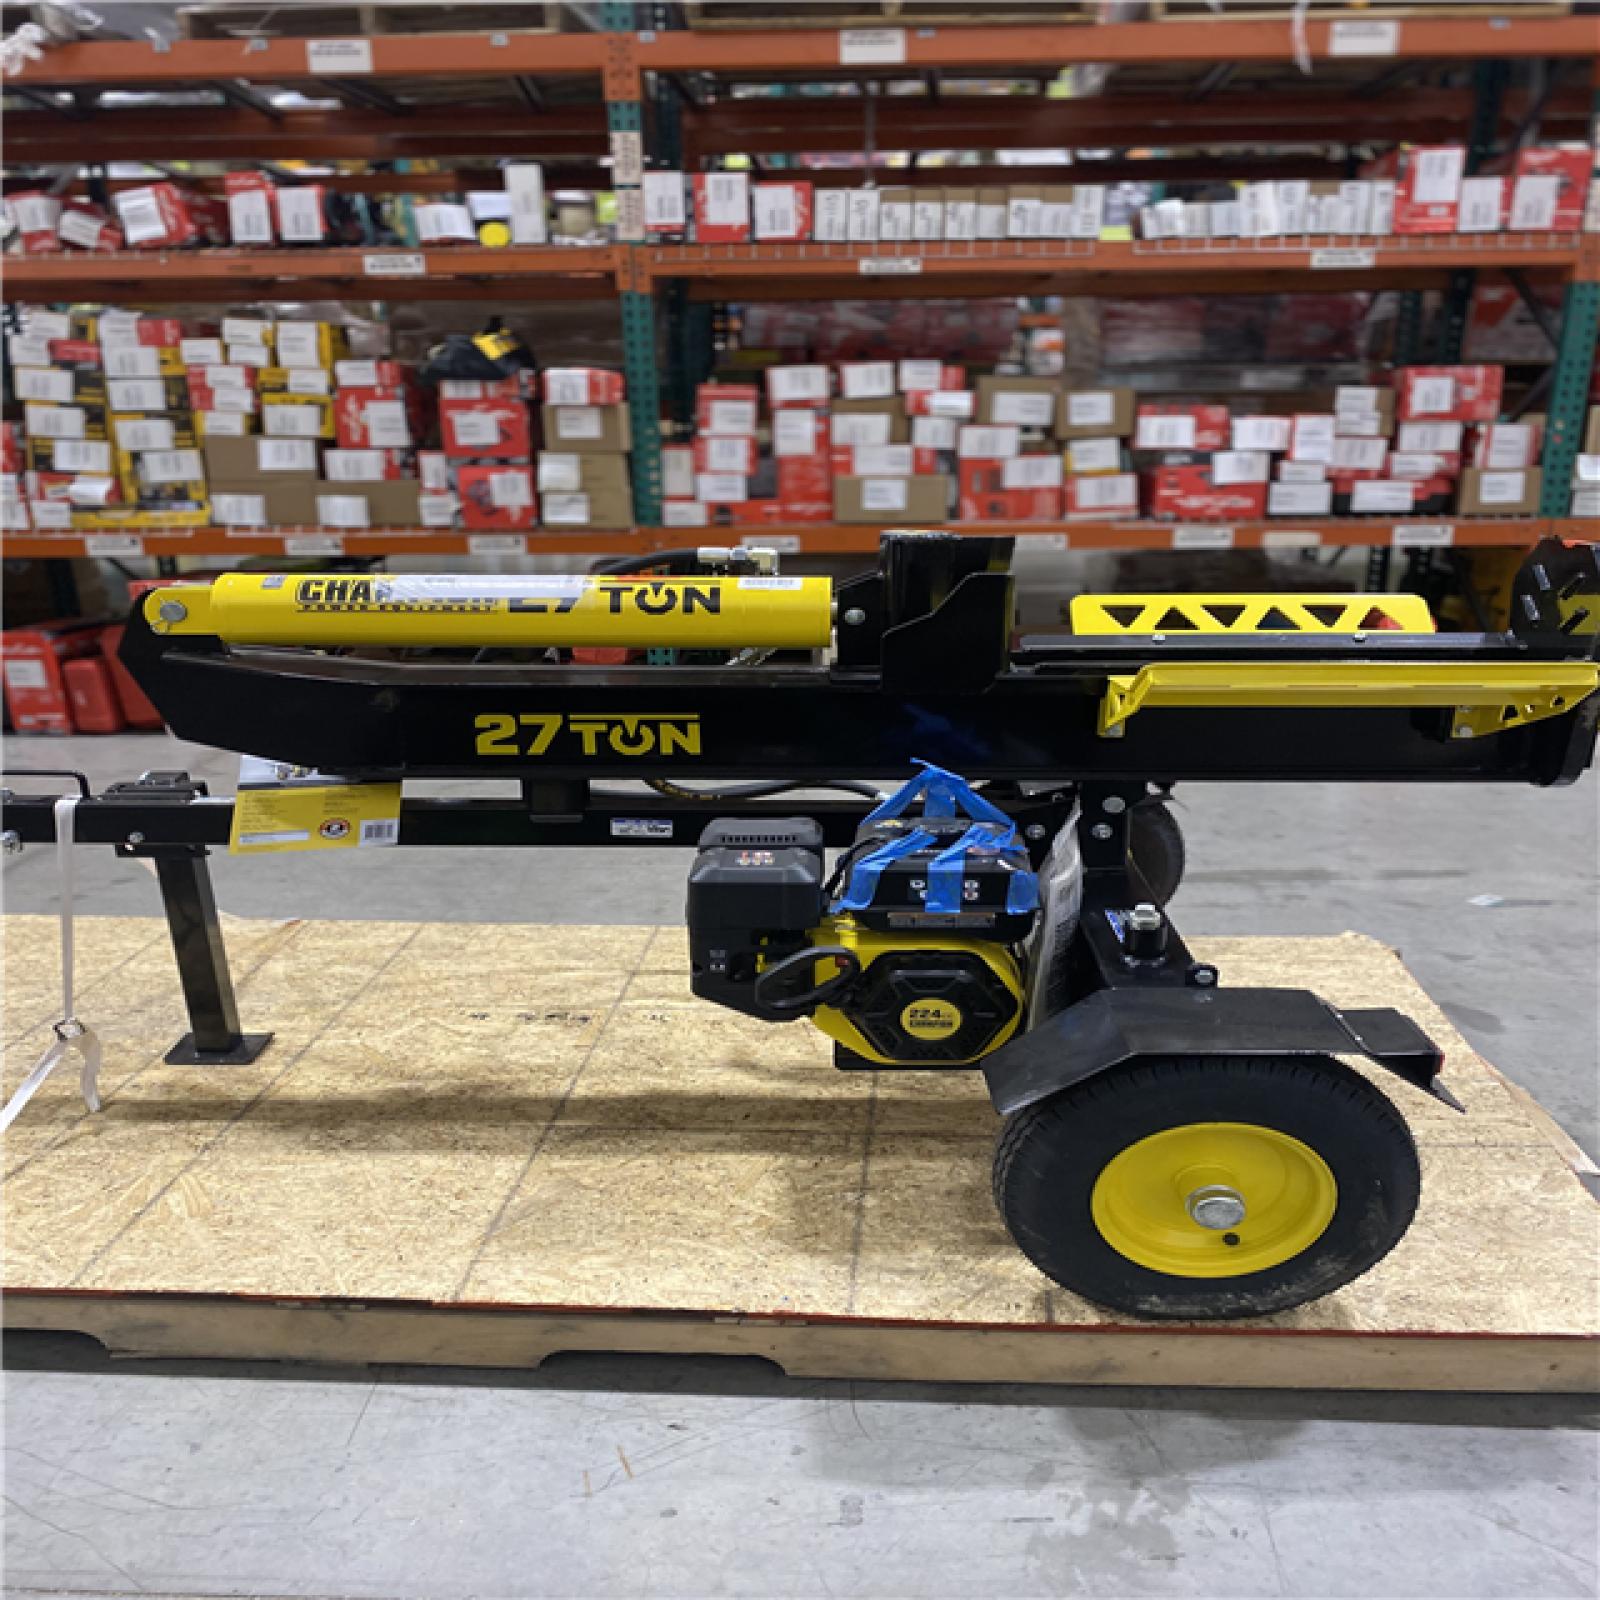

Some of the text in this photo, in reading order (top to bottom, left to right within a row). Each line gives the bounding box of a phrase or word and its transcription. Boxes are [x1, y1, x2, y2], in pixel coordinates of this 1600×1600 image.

[599, 583, 721, 614] TON
[474, 714, 701, 755] 27 TON
